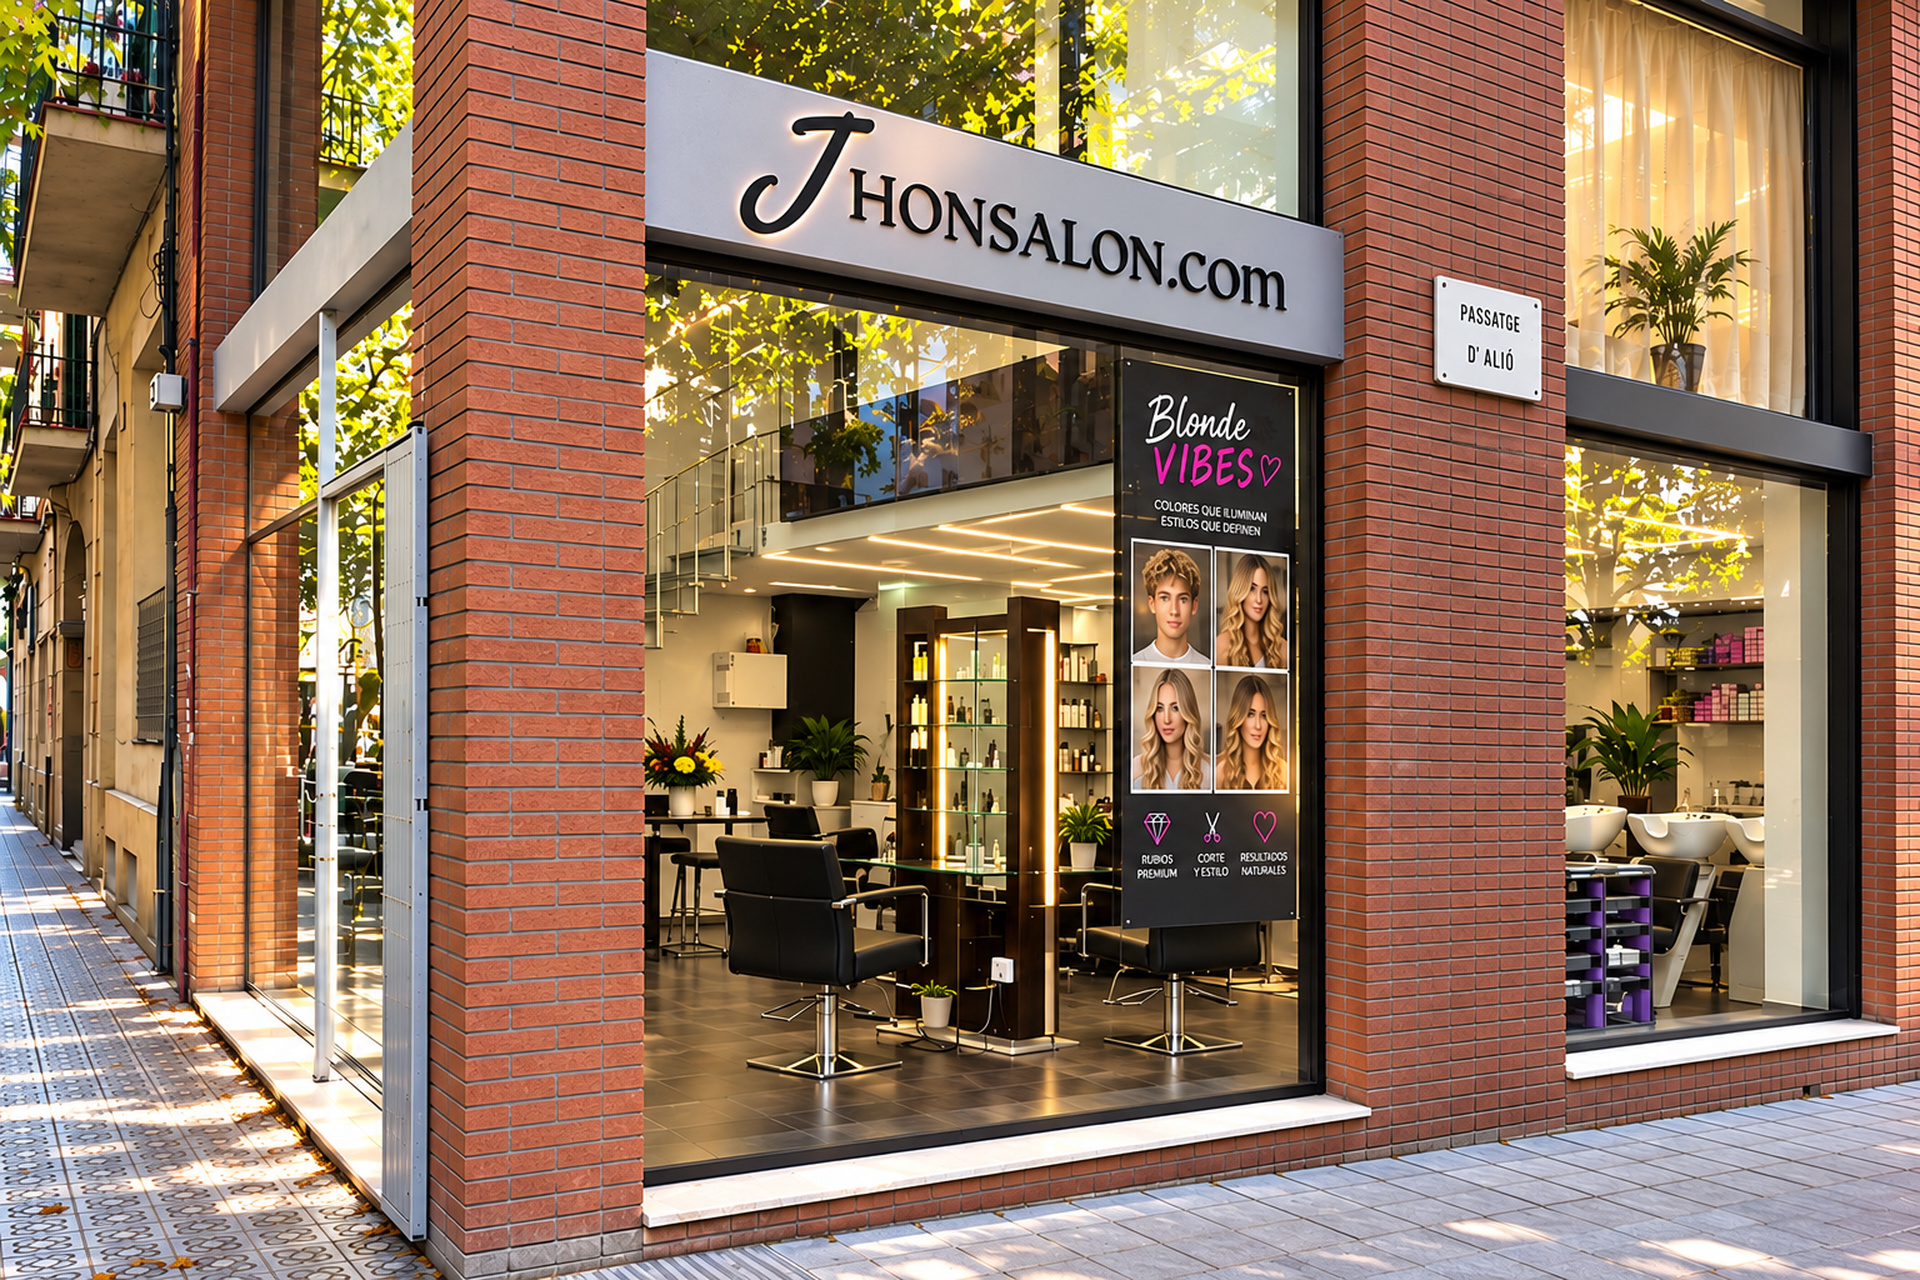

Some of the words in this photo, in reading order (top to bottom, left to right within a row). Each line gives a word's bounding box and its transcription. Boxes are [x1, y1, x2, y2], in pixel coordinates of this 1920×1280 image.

[1460, 303, 1520, 333] PASSATGE
[1468, 345, 1480, 363] D'
[1484, 348, 1514, 371] ALIÓ
[1145, 394, 1251, 444] Blonde
[1154, 442, 1254, 489] VIBES
[1154, 499, 1200, 515] COLORES
[1201, 505, 1221, 518] QUE
[1223, 507, 1267, 523] ILUMINAN
[1161, 515, 1199, 530] ESTILOS
[1200, 520, 1221, 533] QUE
[1223, 522, 1261, 536] DEFINEN
[1197, 852, 1226, 864] CORTE
[1240, 851, 1288, 863] RESULTADOS
[1136, 868, 1178, 880] PREMIUM
[1193, 867, 1200, 877] Y
[1201, 866, 1229, 877] ESTILO
[1241, 865, 1287, 876] NATURALES
